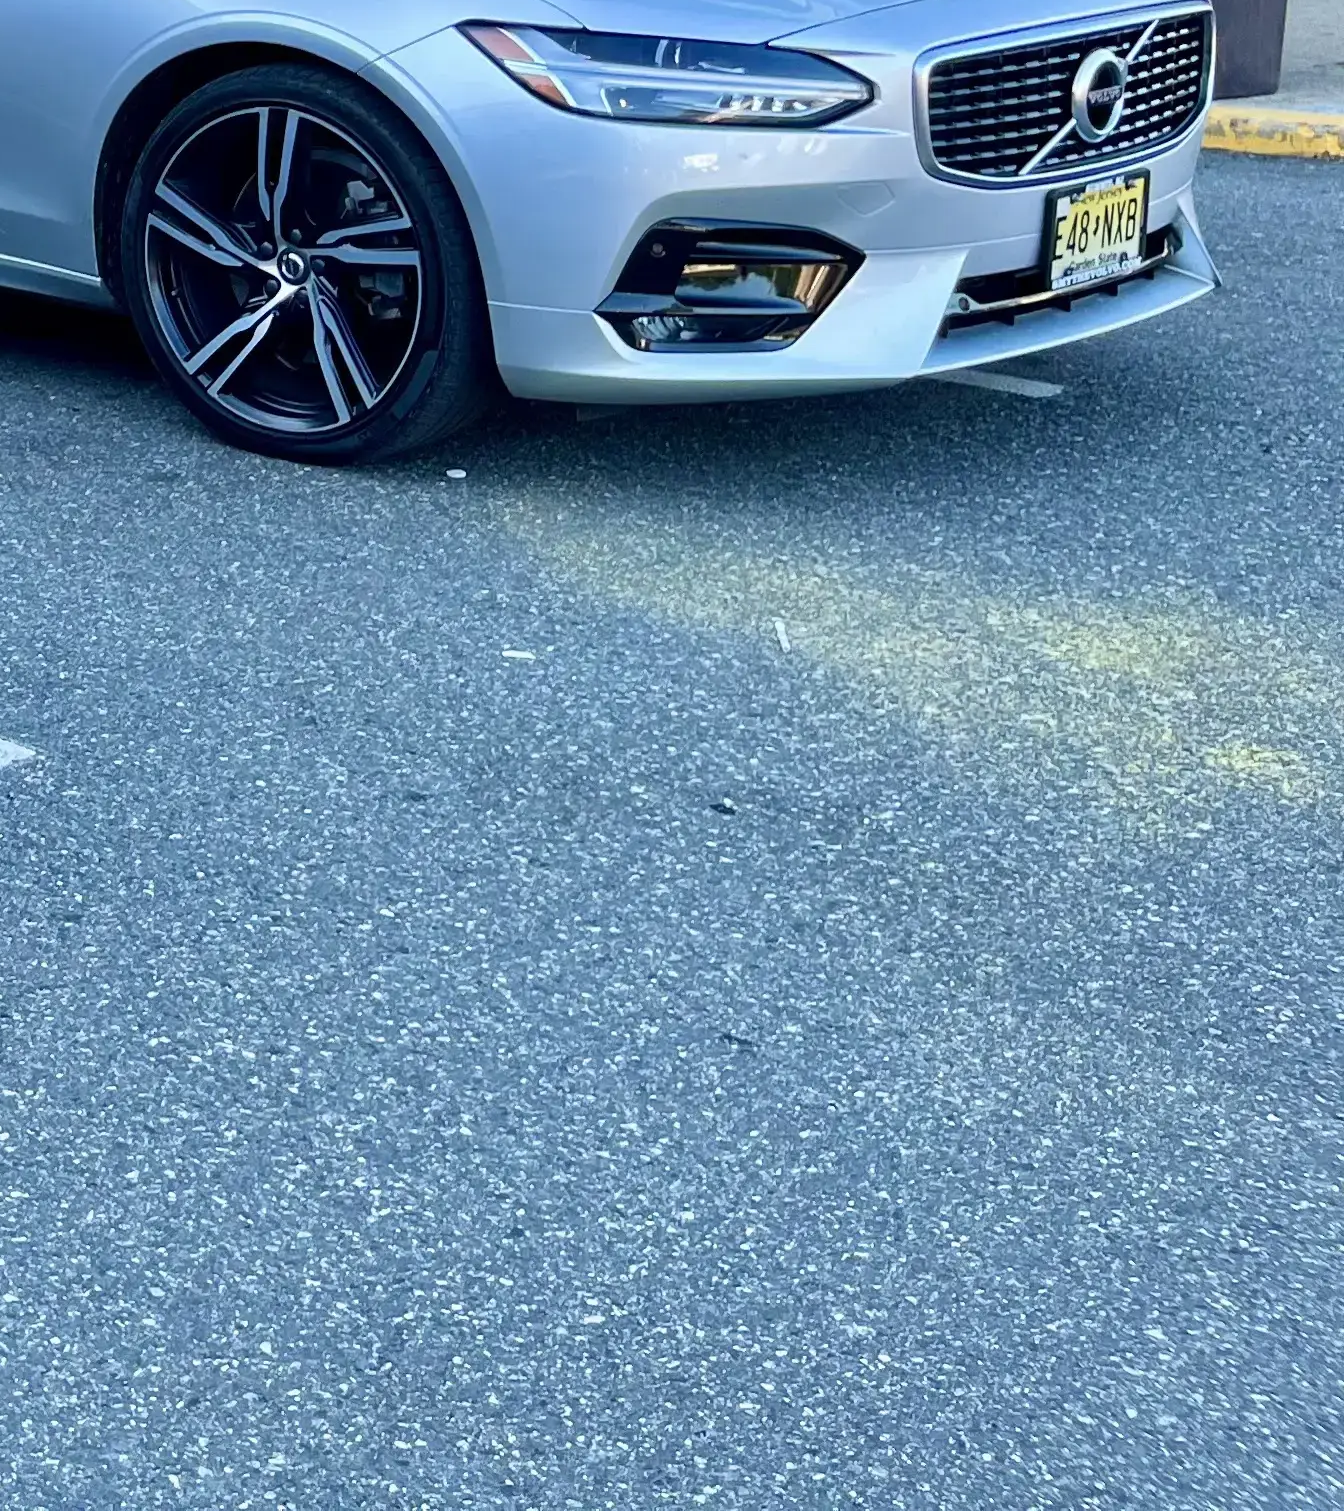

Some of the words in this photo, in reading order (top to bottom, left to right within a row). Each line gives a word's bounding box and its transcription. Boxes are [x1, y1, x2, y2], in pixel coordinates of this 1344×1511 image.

[1088, 88, 1122, 105] VOLVO
[1053, 210, 1090, 260] E48
[1100, 197, 1138, 249] NXB
